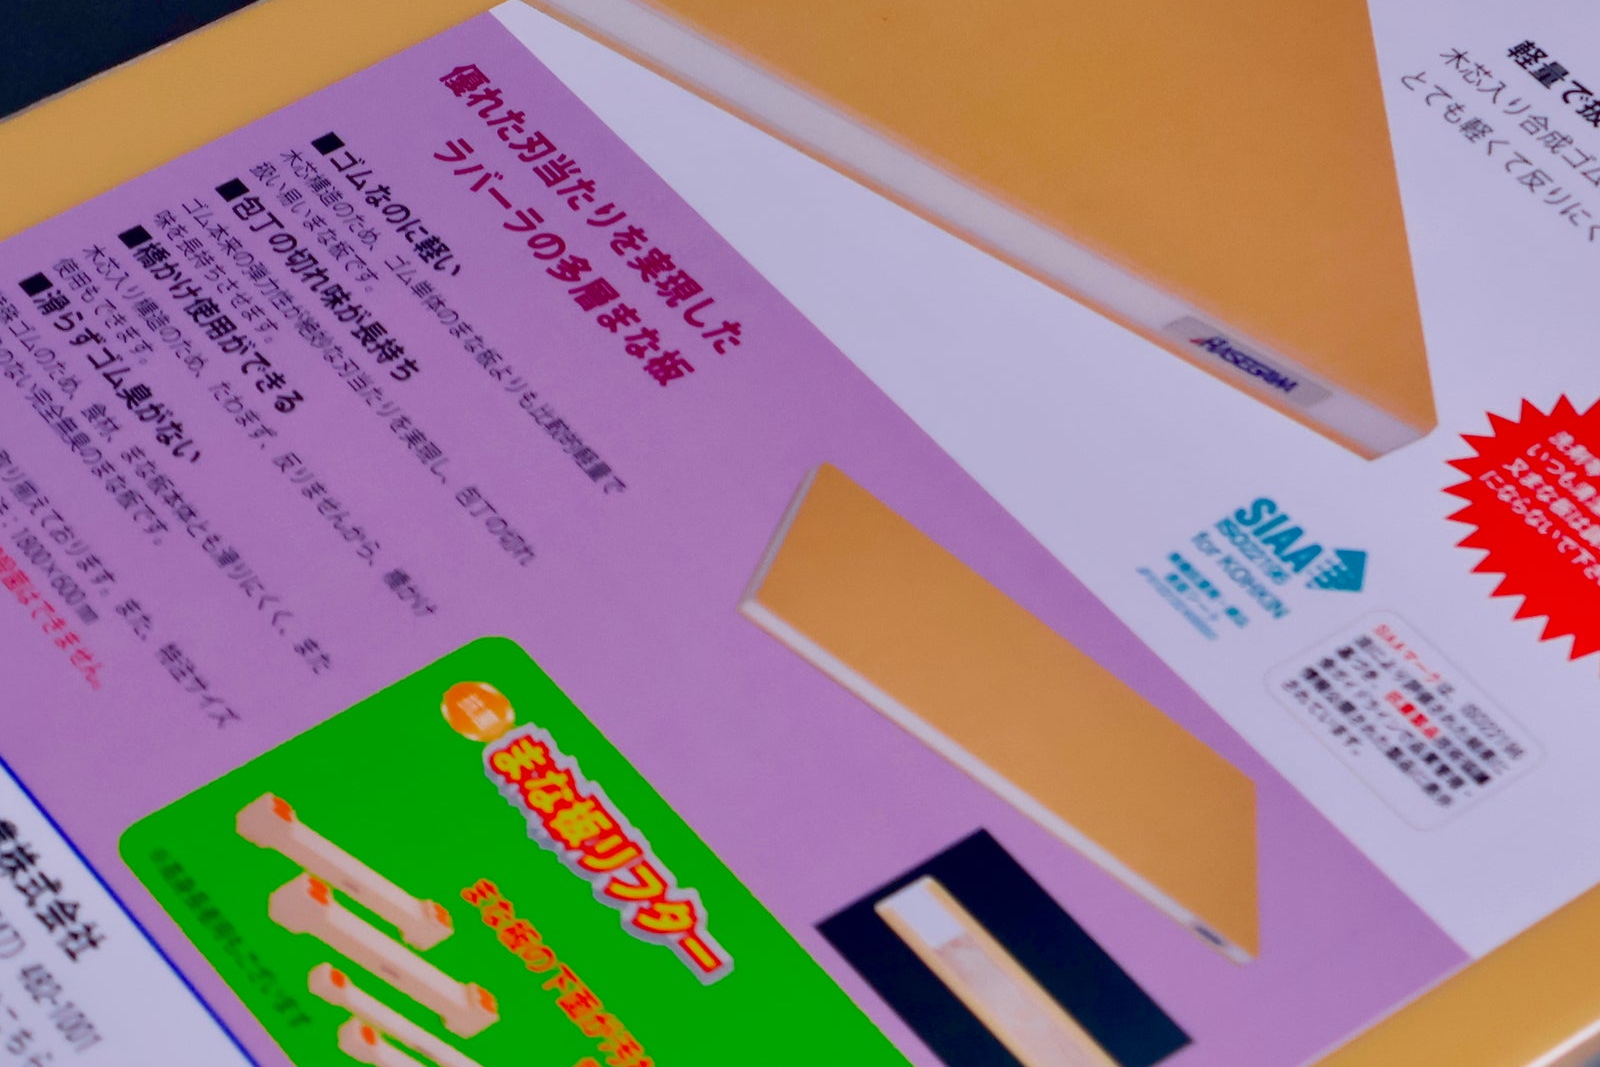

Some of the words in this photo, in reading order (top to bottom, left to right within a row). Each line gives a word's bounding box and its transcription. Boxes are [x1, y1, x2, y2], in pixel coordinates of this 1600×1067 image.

[433, 138, 695, 387] ラバーラの多層まな板
[439, 64, 741, 355] 優れた刃当たりを実現した
[1234, 498, 1323, 573] SIAA
[489, 734, 723, 973] まな板リフター
